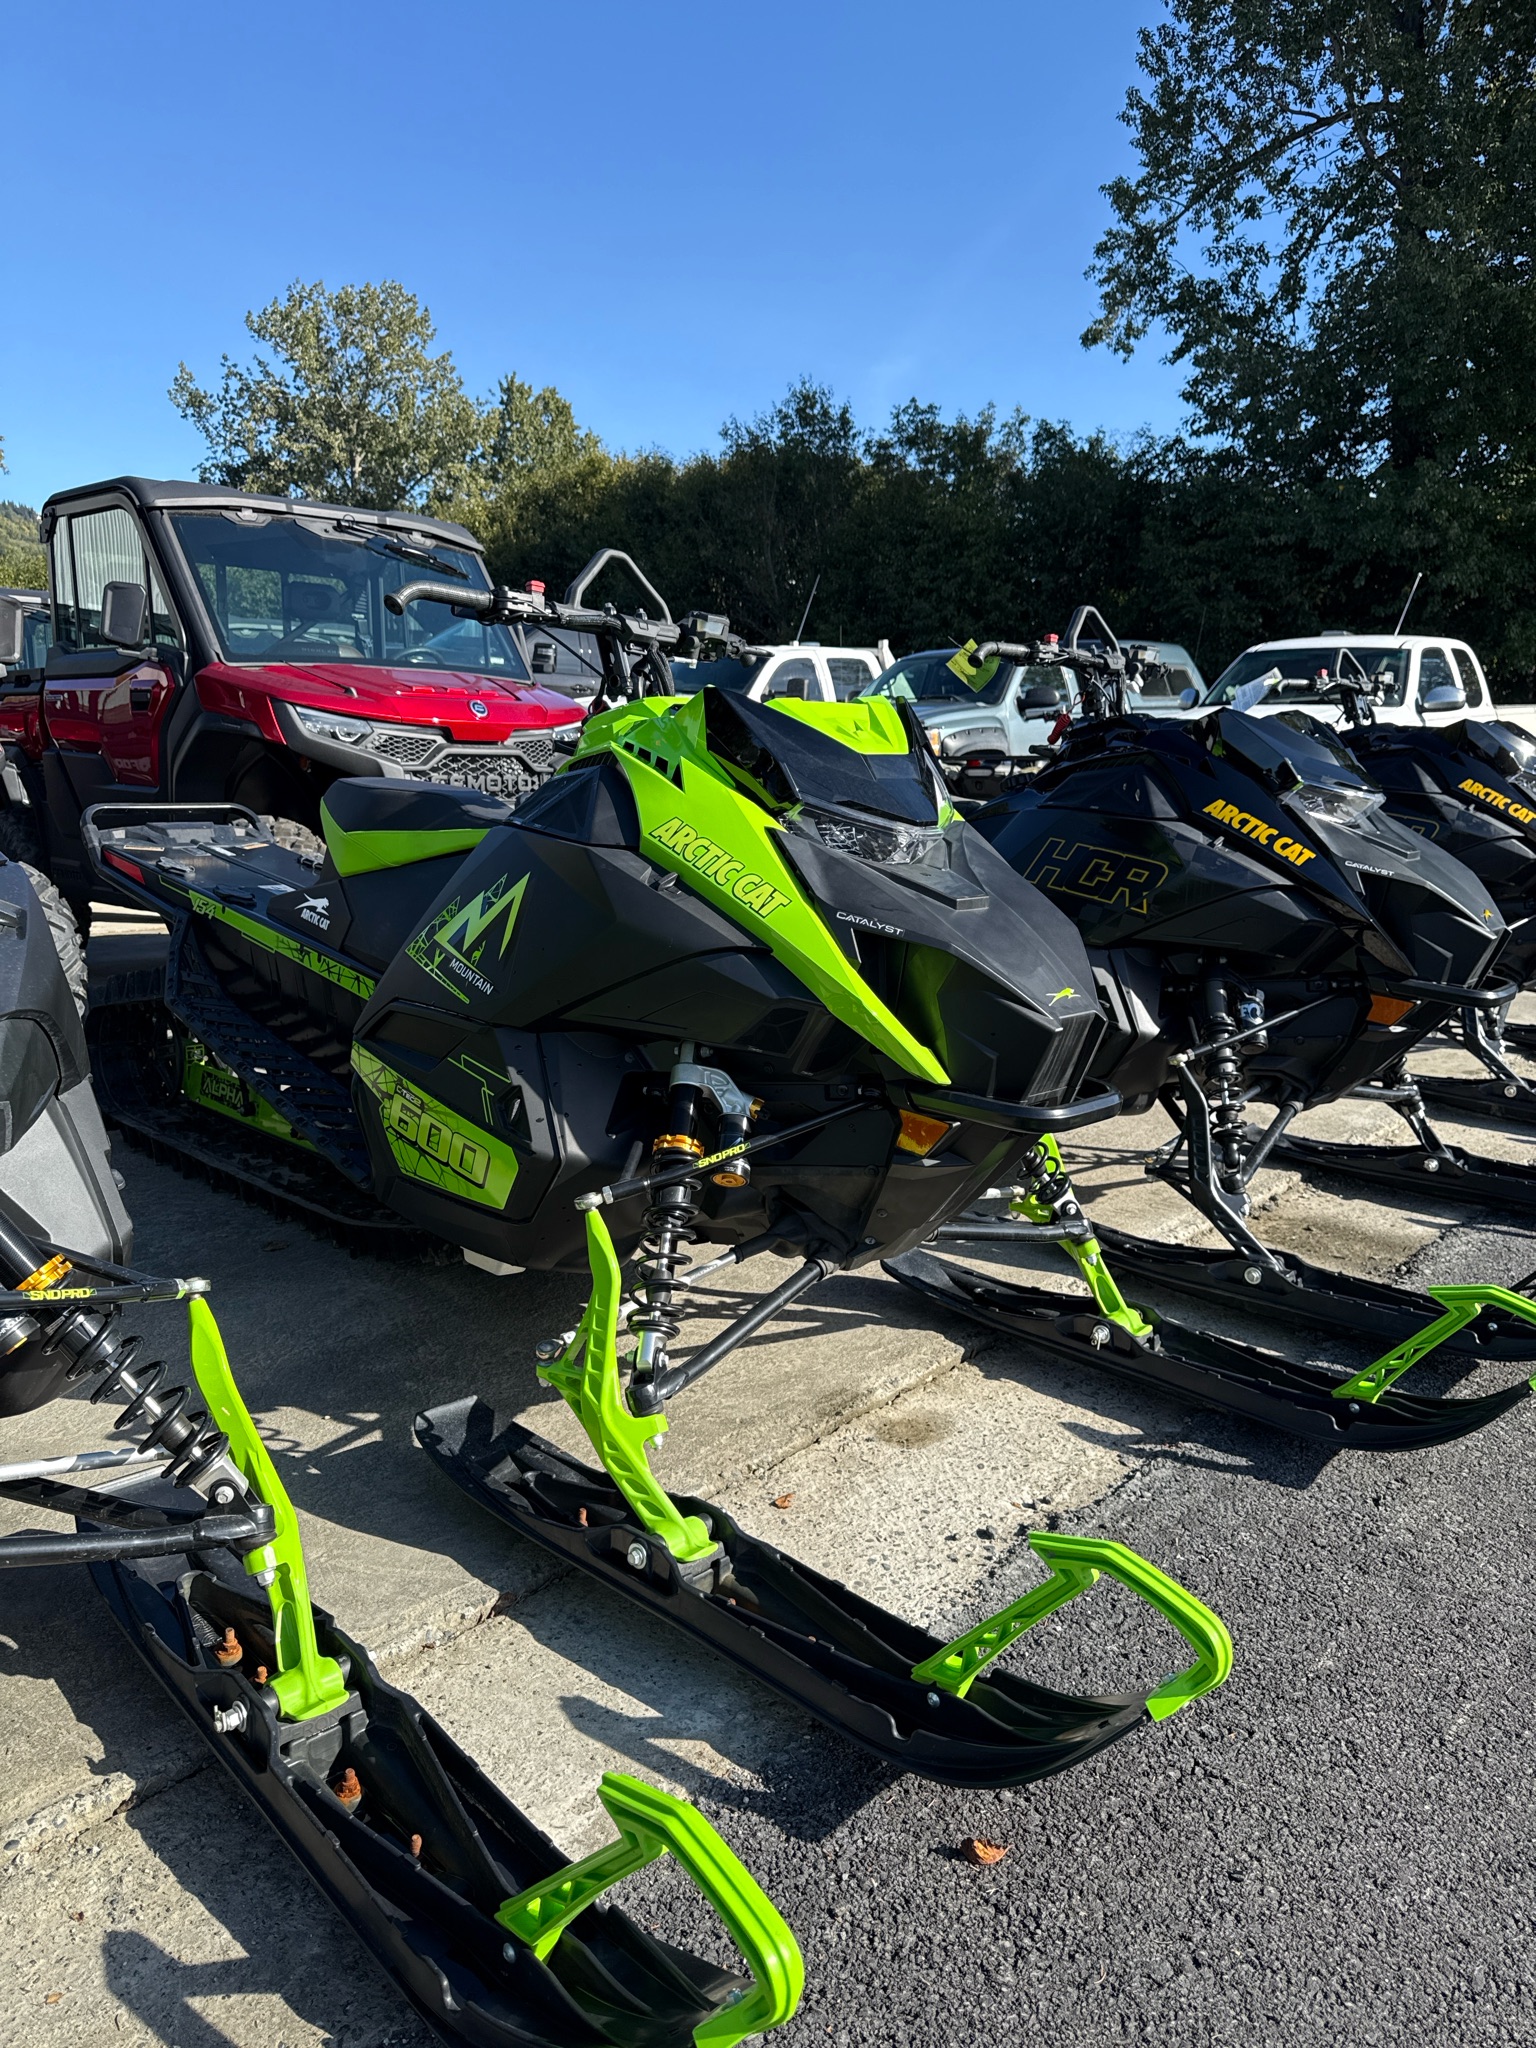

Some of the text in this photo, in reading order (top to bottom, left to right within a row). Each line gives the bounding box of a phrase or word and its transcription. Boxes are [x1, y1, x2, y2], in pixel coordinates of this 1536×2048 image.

[1457, 778, 1536, 824] ARCTIC CAT
[1202, 799, 1317, 867] ARCTIC CAT
[648, 816, 792, 919] ARCTIC CAT
[1023, 837, 1169, 915] HCR
[1344, 860, 1395, 877] CATALYST
[193, 899, 217, 920] 154
[300, 907, 331, 931] ARCTIC CAT
[836, 911, 904, 936] CATALYST
[449, 958, 495, 996] MOUNTAIN
[202, 1077, 244, 1109] ALPHA
[389, 1093, 492, 1190] 600
